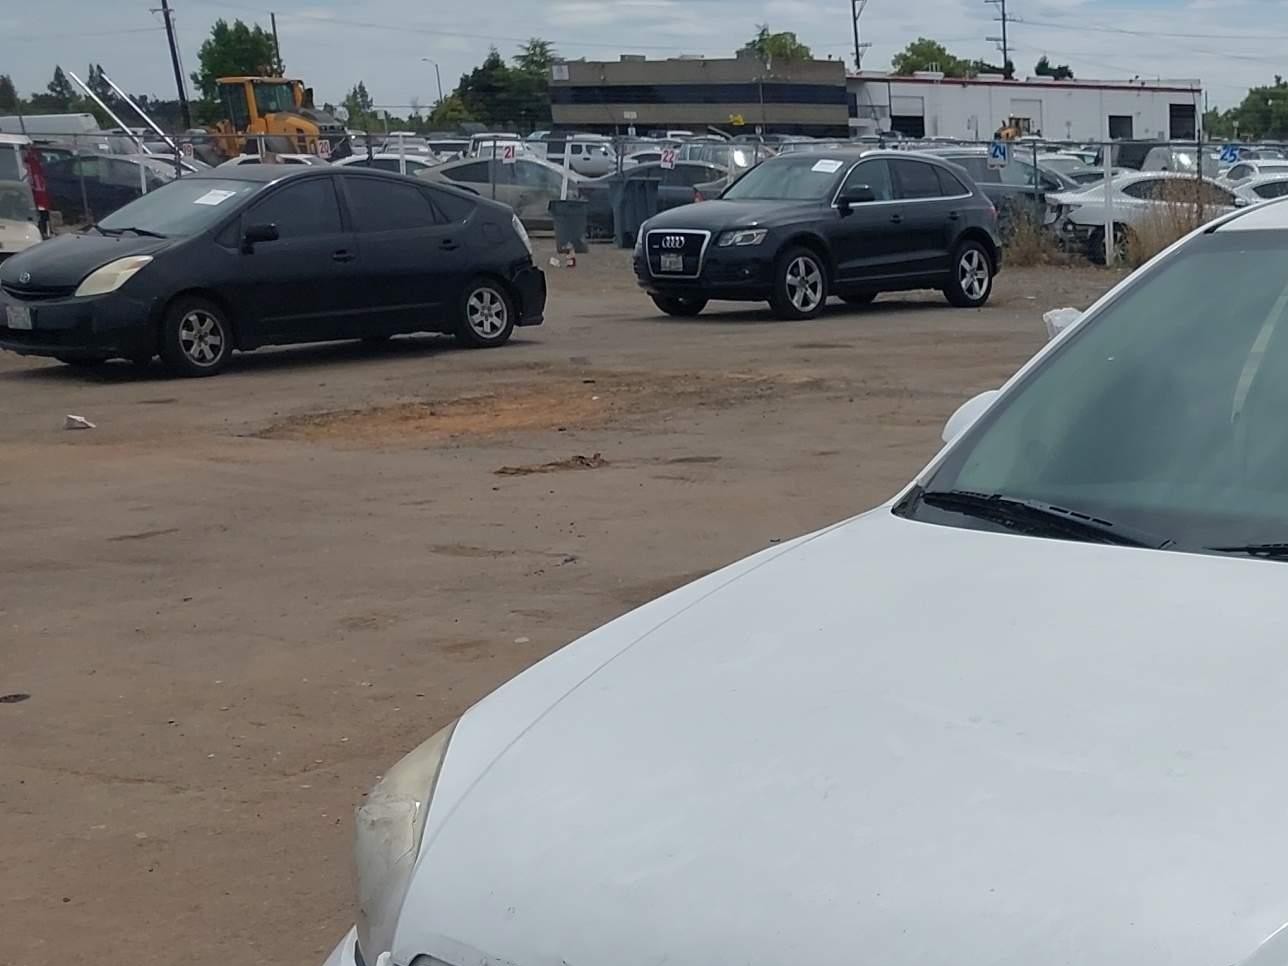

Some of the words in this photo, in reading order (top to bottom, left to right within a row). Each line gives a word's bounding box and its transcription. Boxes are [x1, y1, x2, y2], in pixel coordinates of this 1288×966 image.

[503, 145, 515, 159] 21
[663, 150, 674, 165] 22
[991, 142, 1006, 160] 24
[1220, 145, 1237, 163] 25
